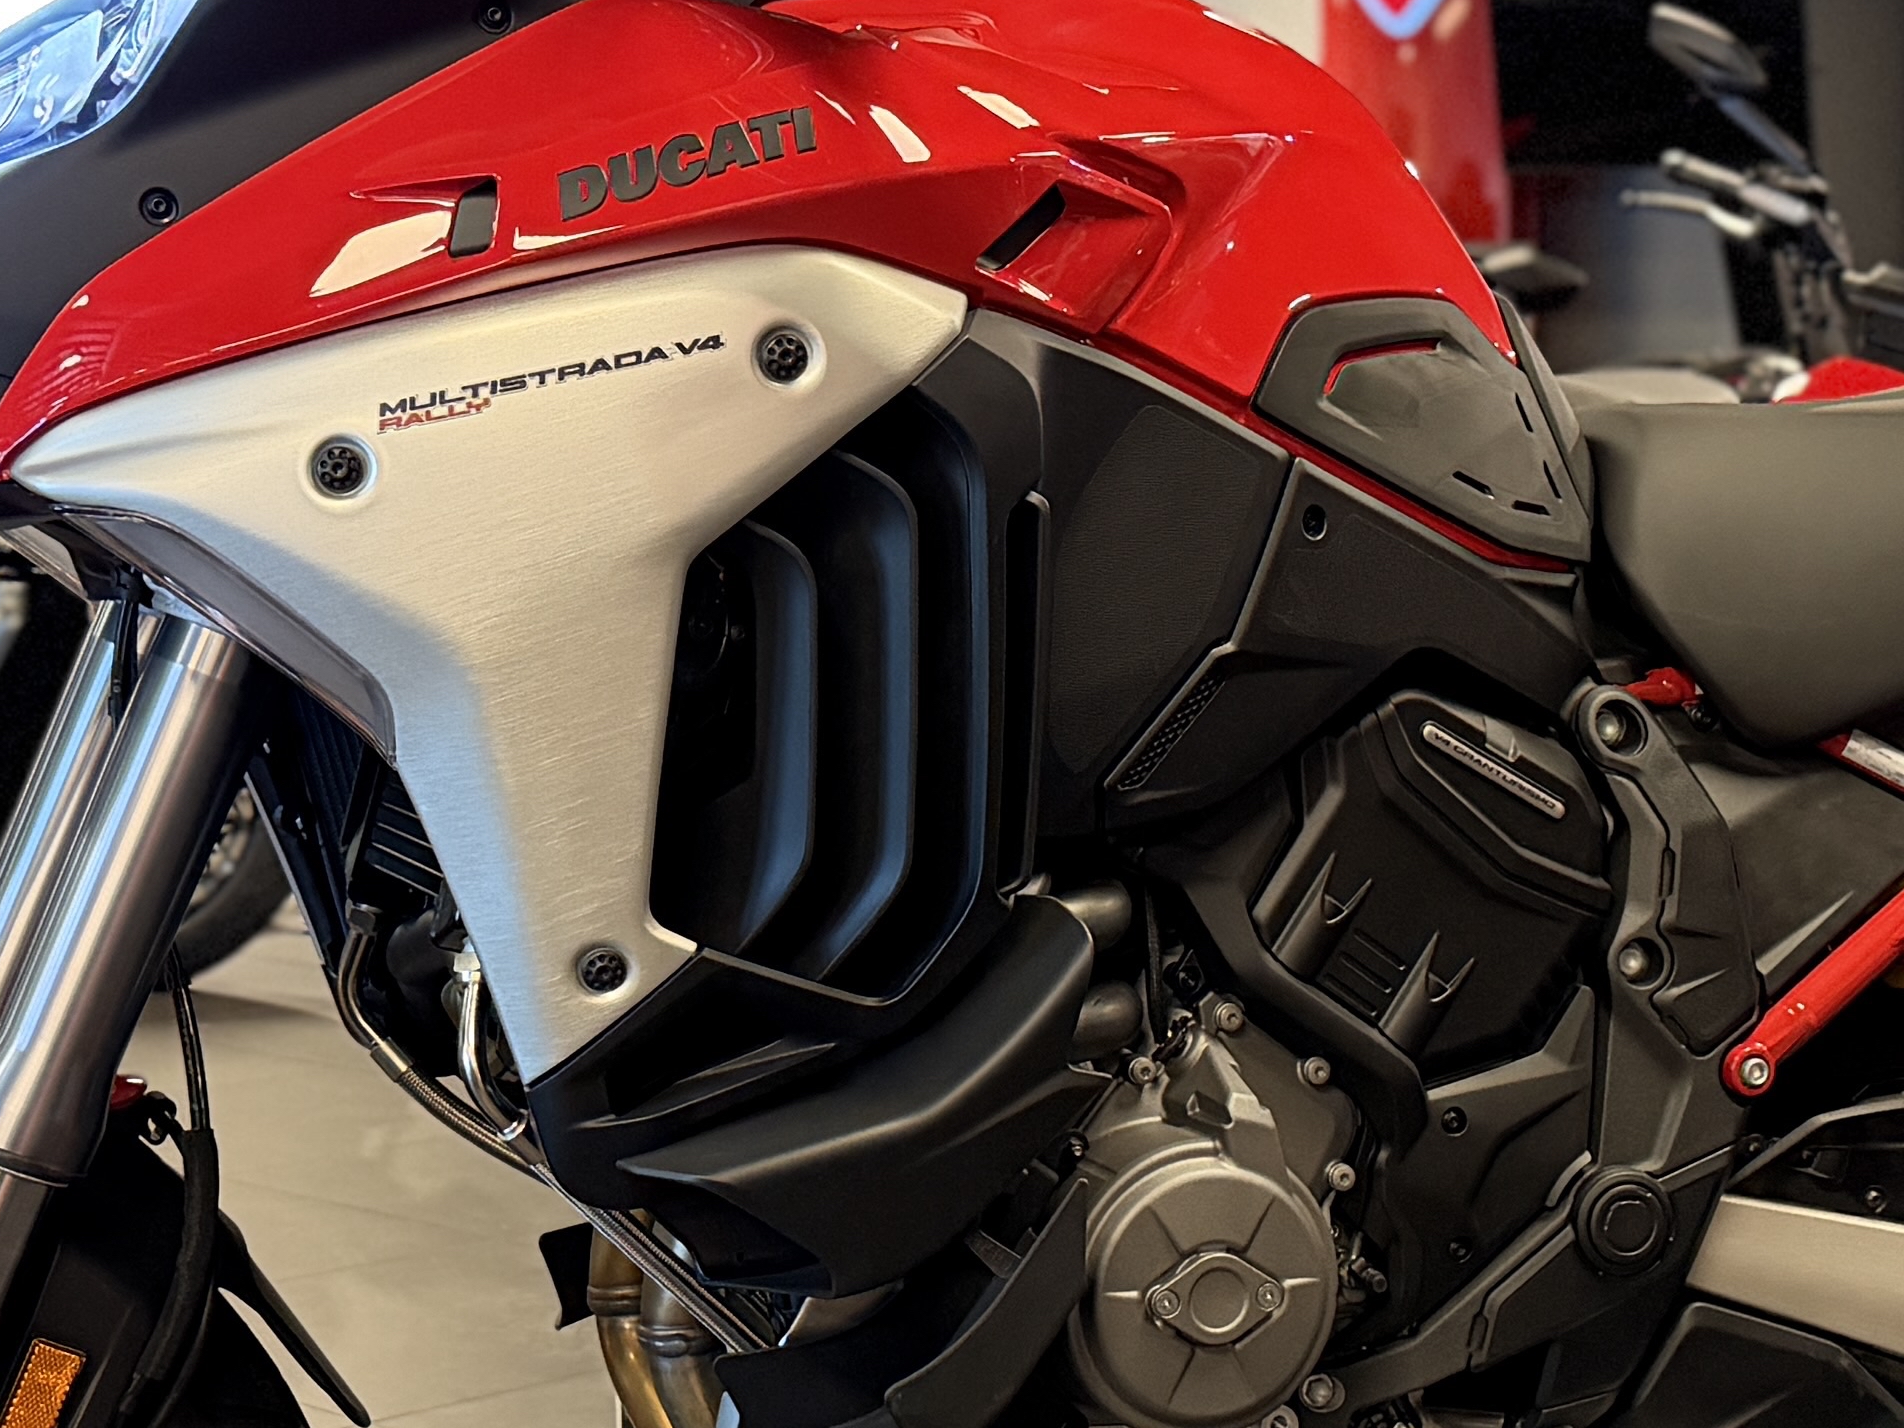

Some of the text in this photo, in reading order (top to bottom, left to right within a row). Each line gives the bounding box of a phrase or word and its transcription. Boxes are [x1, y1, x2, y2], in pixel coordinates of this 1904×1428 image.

[558, 107, 817, 221] DUCATI
[378, 333, 725, 417] MULTISTRADA V4
[378, 398, 491, 433] RALLY
[1434, 733, 1555, 809] V4 GRANTURISMO
